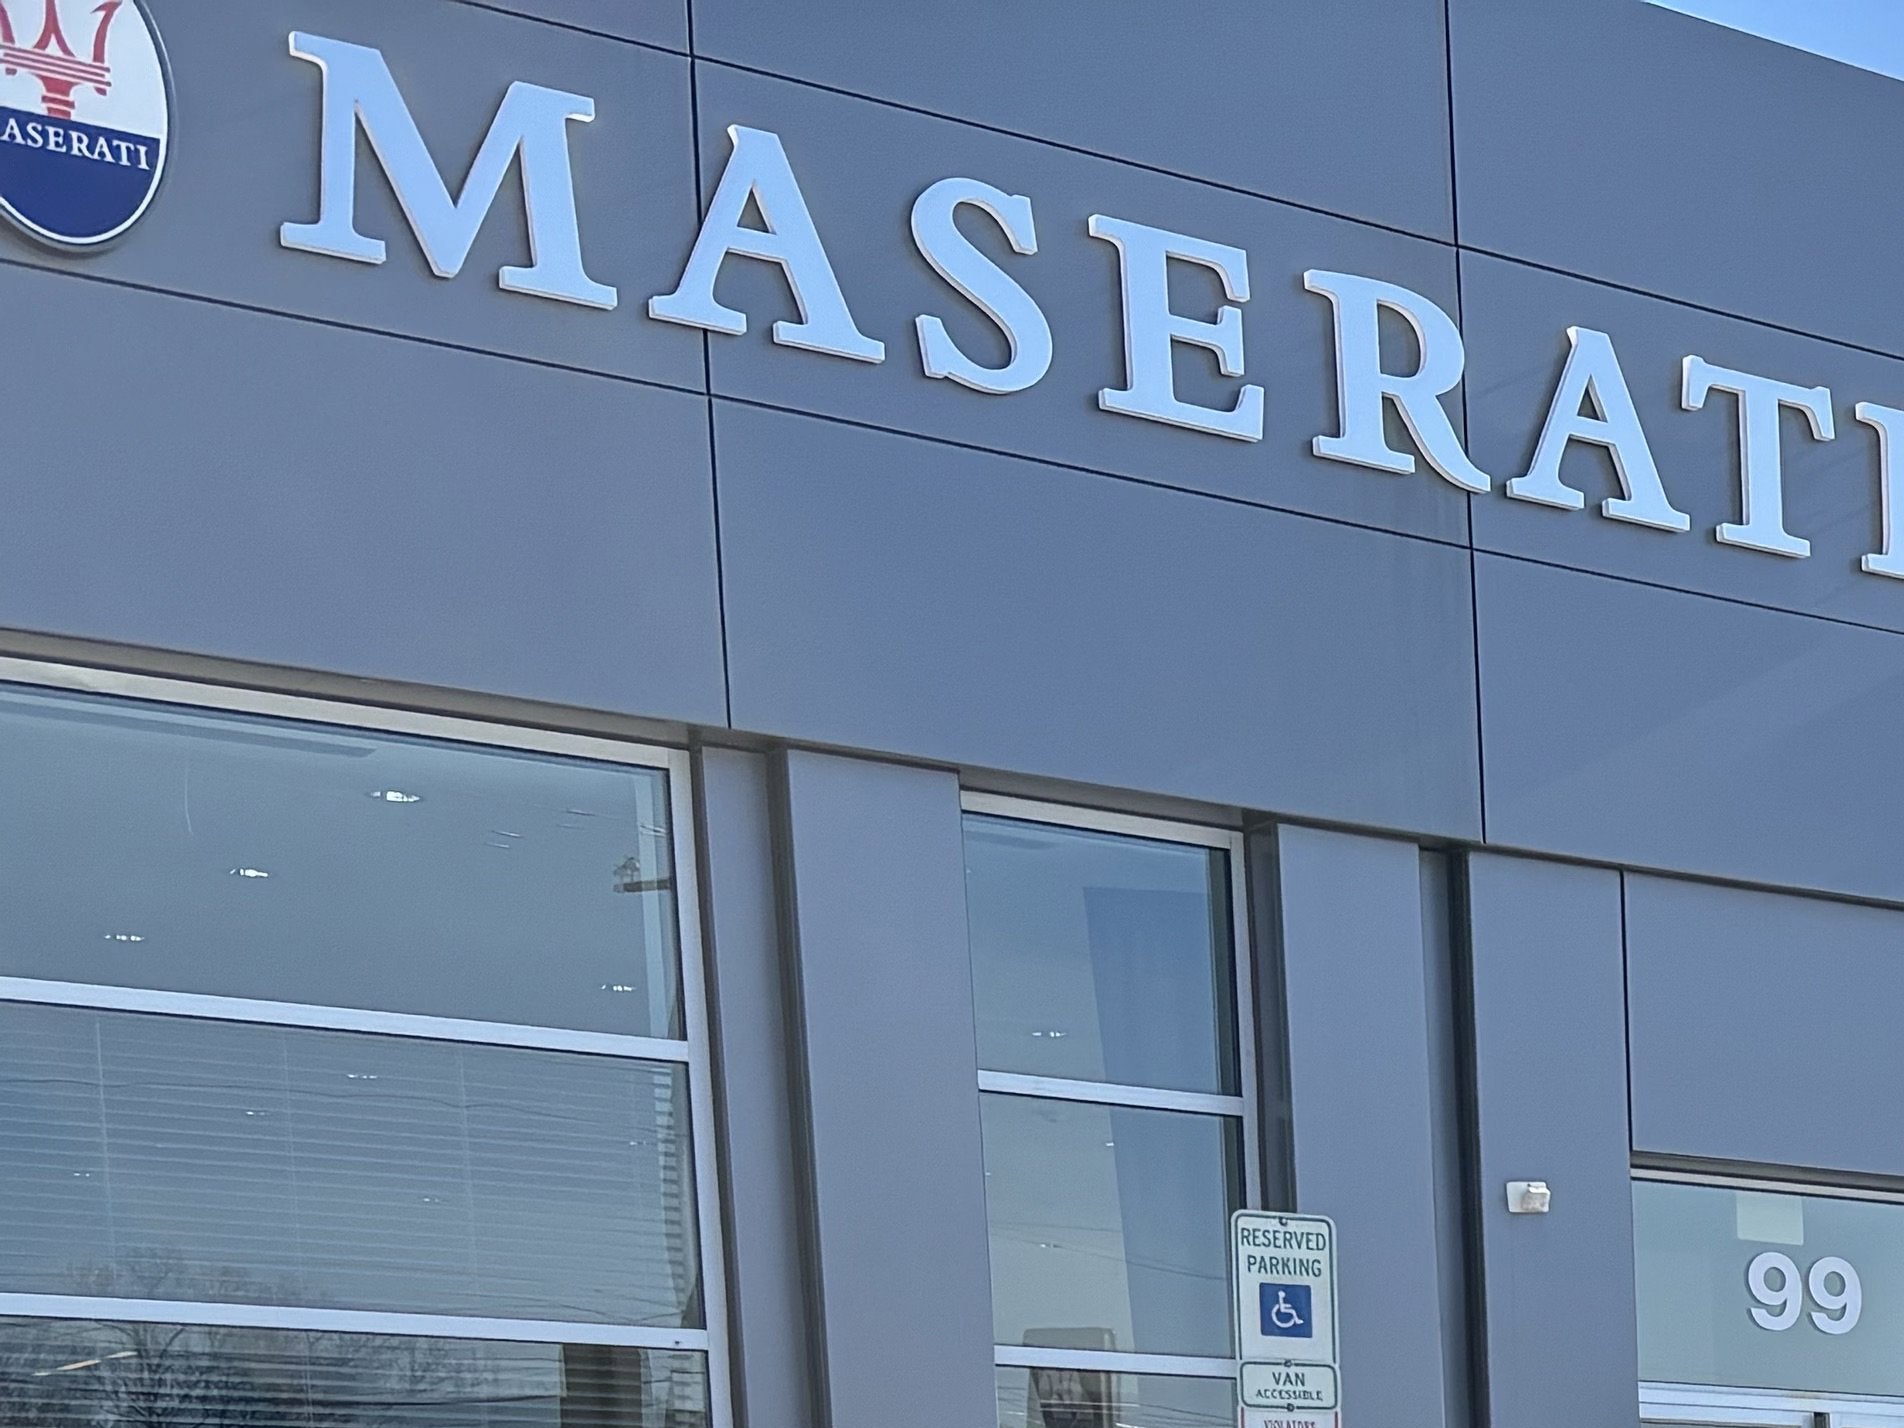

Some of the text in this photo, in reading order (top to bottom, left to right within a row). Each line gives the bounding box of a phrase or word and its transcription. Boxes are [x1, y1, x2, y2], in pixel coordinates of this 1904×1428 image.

[1241, 1228, 1326, 1251] RESERVED
[1247, 1255, 1322, 1277] PARKING
[1747, 1252, 1863, 1335] 99
[1272, 1372, 1305, 1387] VAN
[1256, 1389, 1323, 1401] ACCESSIBLE
